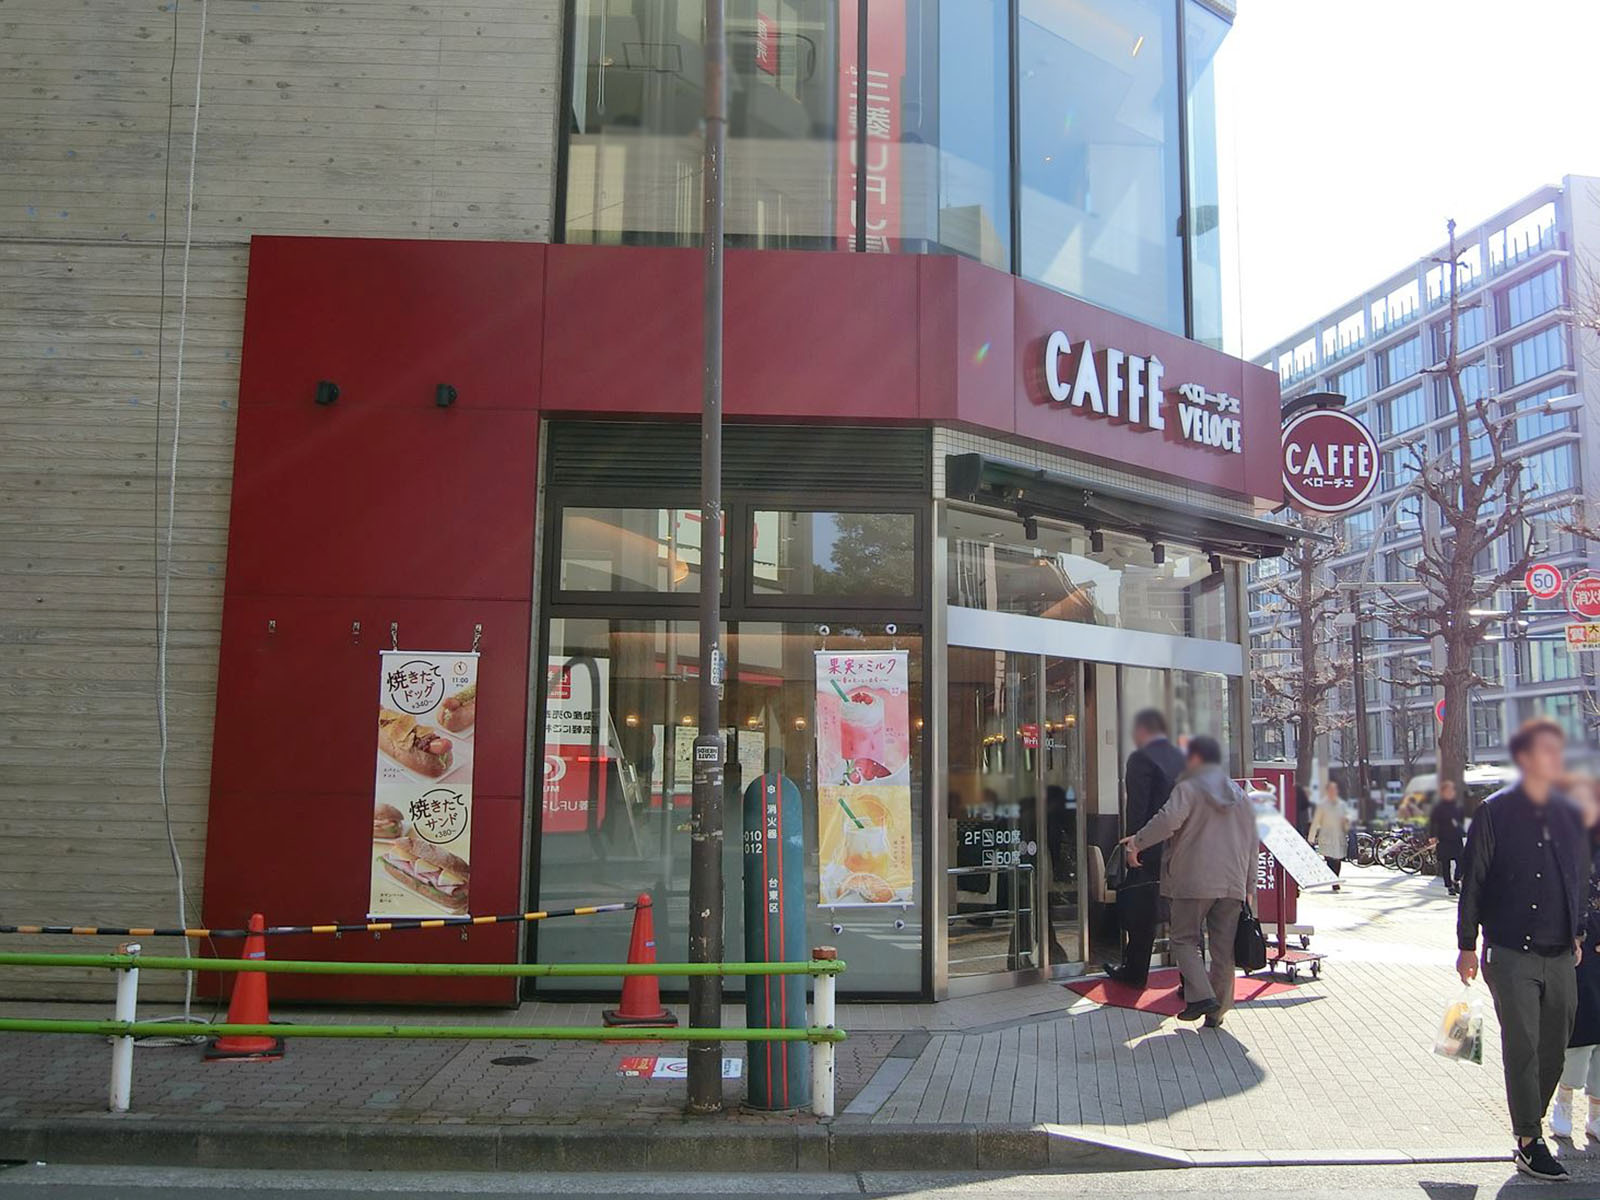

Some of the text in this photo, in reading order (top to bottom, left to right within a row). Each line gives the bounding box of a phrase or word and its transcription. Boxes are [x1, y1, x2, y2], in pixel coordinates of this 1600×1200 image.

[1045, 330, 1165, 430] CAFFÈ
[1178, 382, 1240, 414] ベローチェ
[1178, 402, 1241, 453] VELOCE
[1302, 477, 1354, 488] ベローチェ
[1533, 573, 1554, 589] 50
[1575, 589, 1600, 606] 消火
[386, 665, 441, 692] 焼きたて
[404, 681, 436, 703] ドッグ
[409, 793, 465, 821] 焼きたて
[425, 812, 458, 831] サンド
[965, 829, 1021, 845] 2F 80席
[744, 843, 762, 854] 012
[768, 878, 779, 913] 台東区
